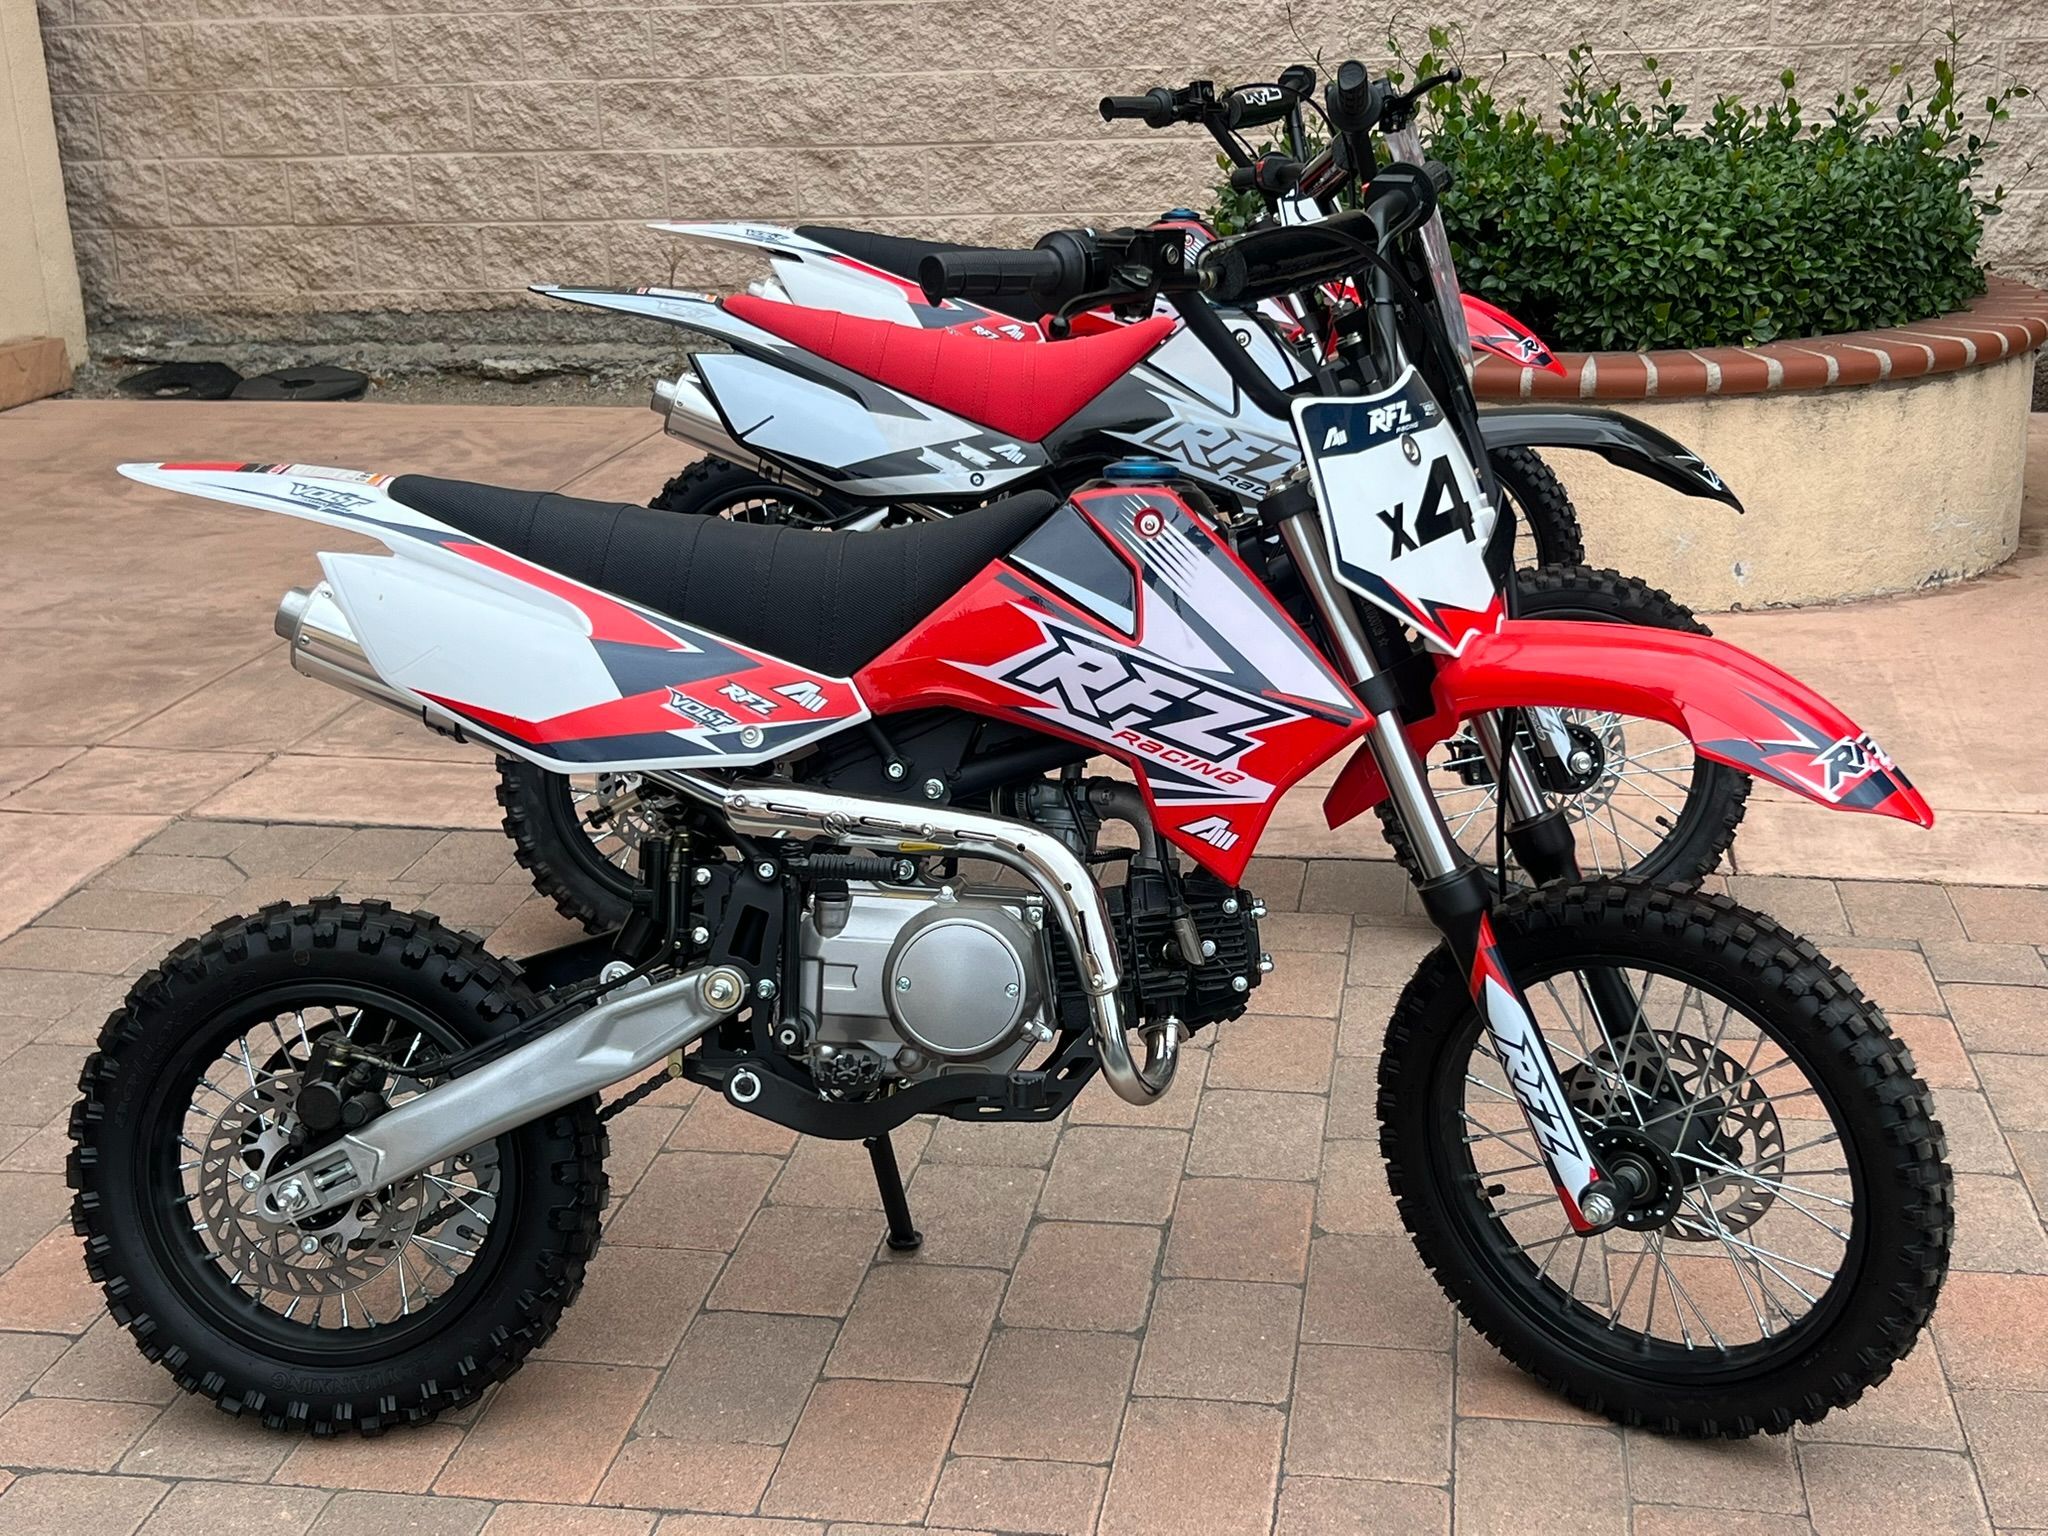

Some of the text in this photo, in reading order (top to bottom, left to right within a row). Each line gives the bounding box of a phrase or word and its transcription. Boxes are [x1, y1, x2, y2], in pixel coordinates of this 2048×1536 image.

[1366, 399, 1412, 436] RFZ
[289, 481, 376, 508] VOLT
[669, 688, 738, 728] VOLT
[716, 679, 782, 717] RFZ
[998, 620, 1297, 764] RFZ
[1494, 1026, 1582, 1161] RFZ
